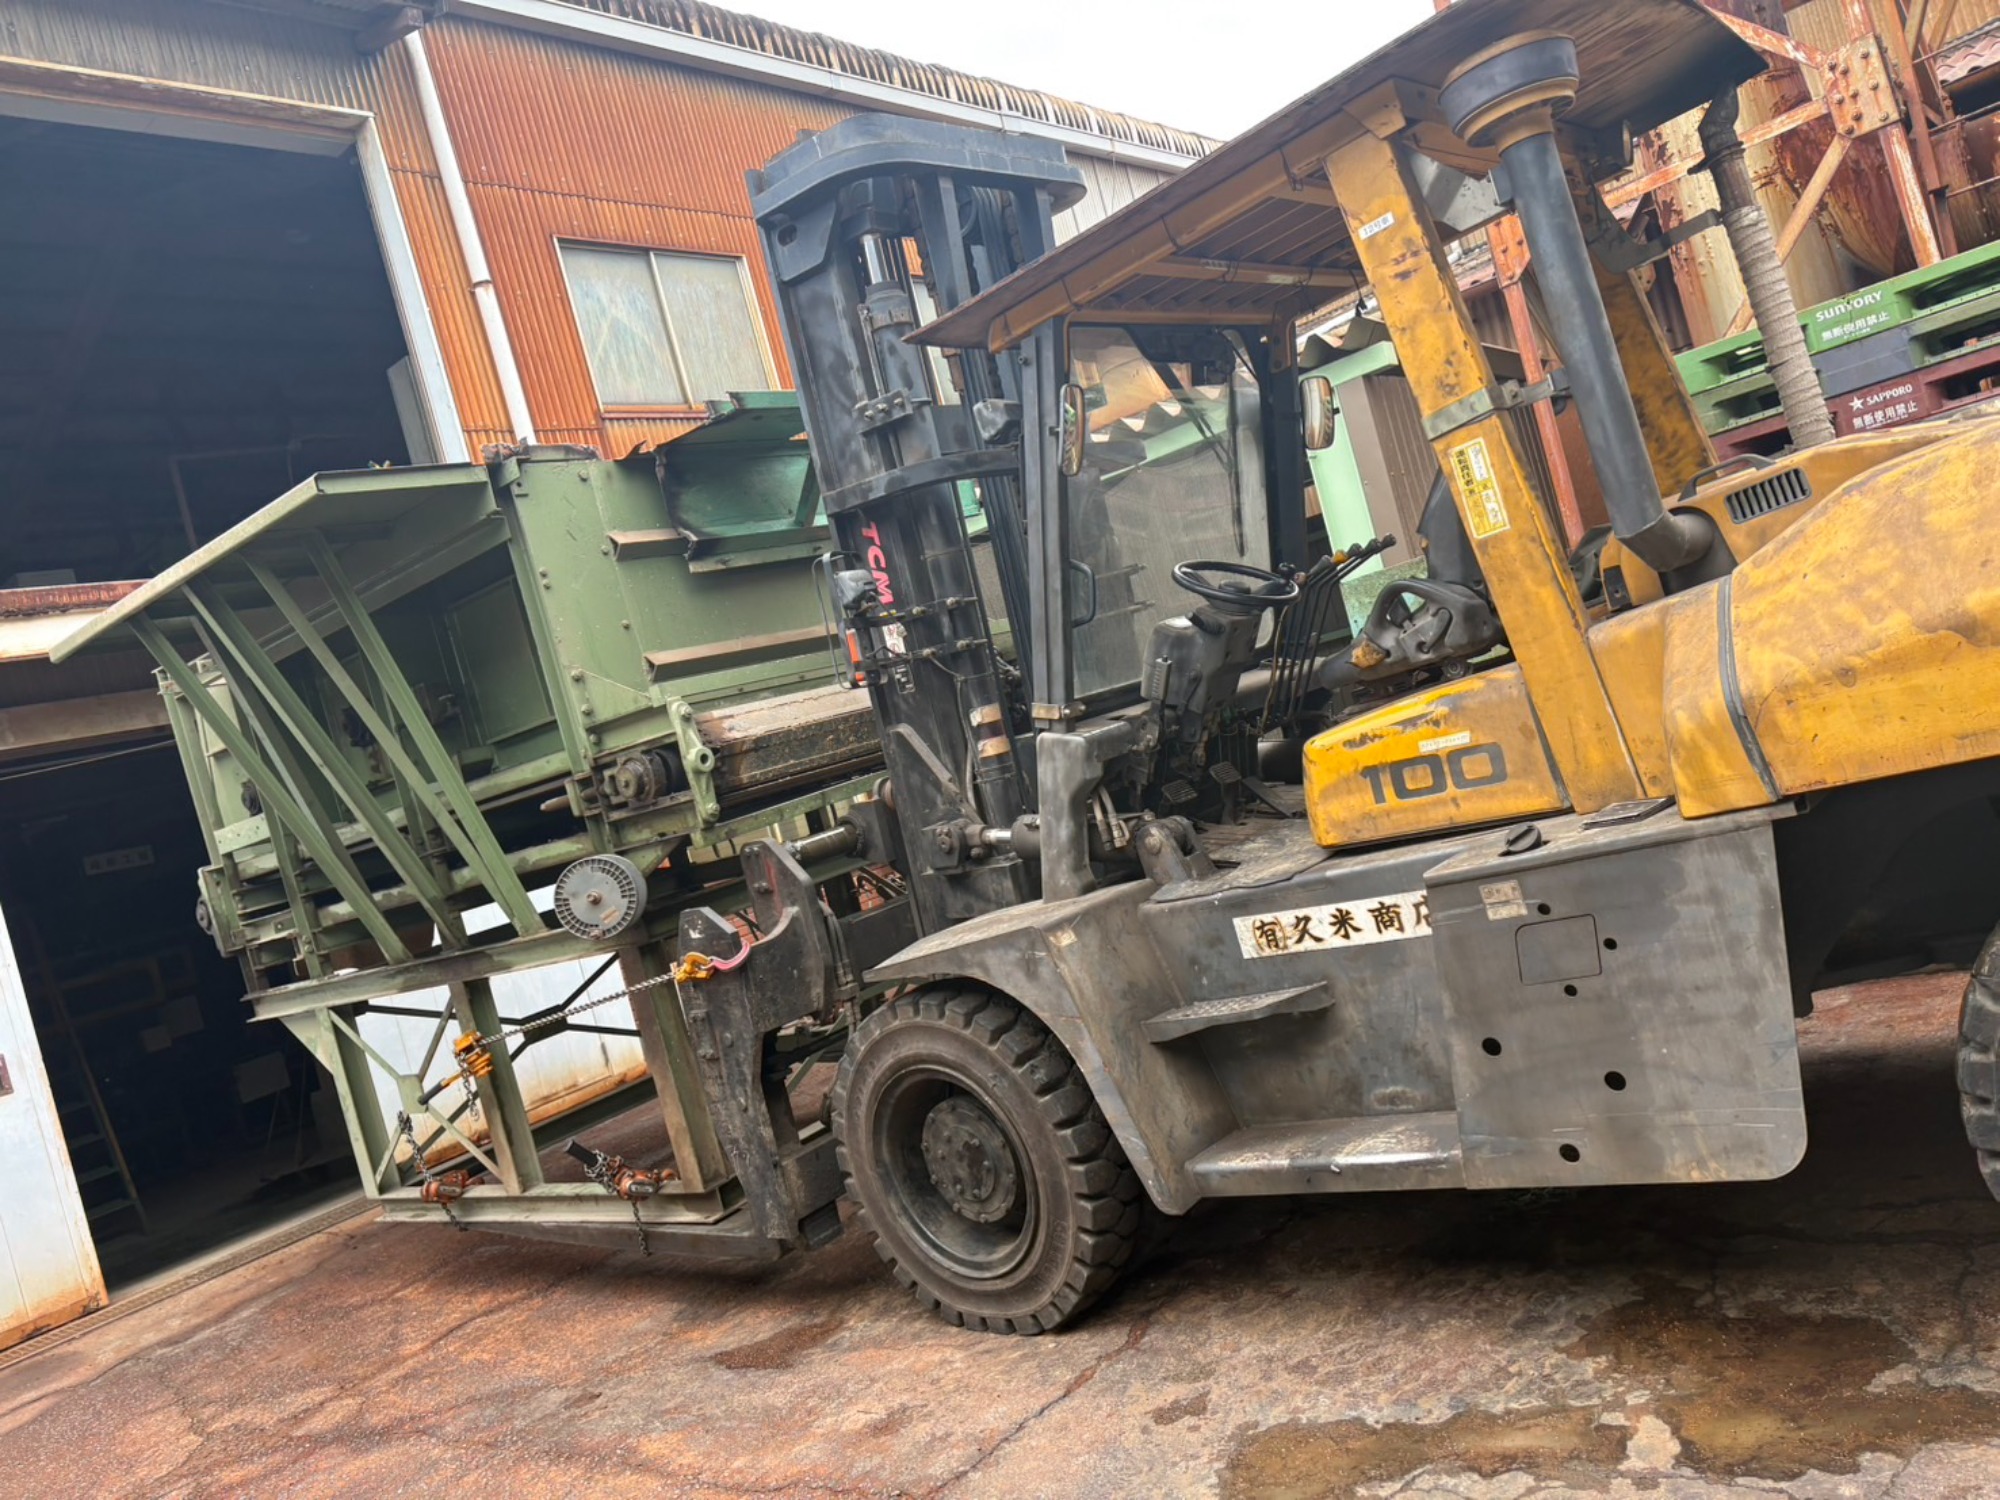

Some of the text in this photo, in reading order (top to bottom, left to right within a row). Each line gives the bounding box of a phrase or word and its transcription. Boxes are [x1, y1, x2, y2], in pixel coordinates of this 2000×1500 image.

[1866, 384, 1913, 405] SAPPORO
[861, 521, 894, 605] TCM
[1361, 742, 1507, 804] 100
